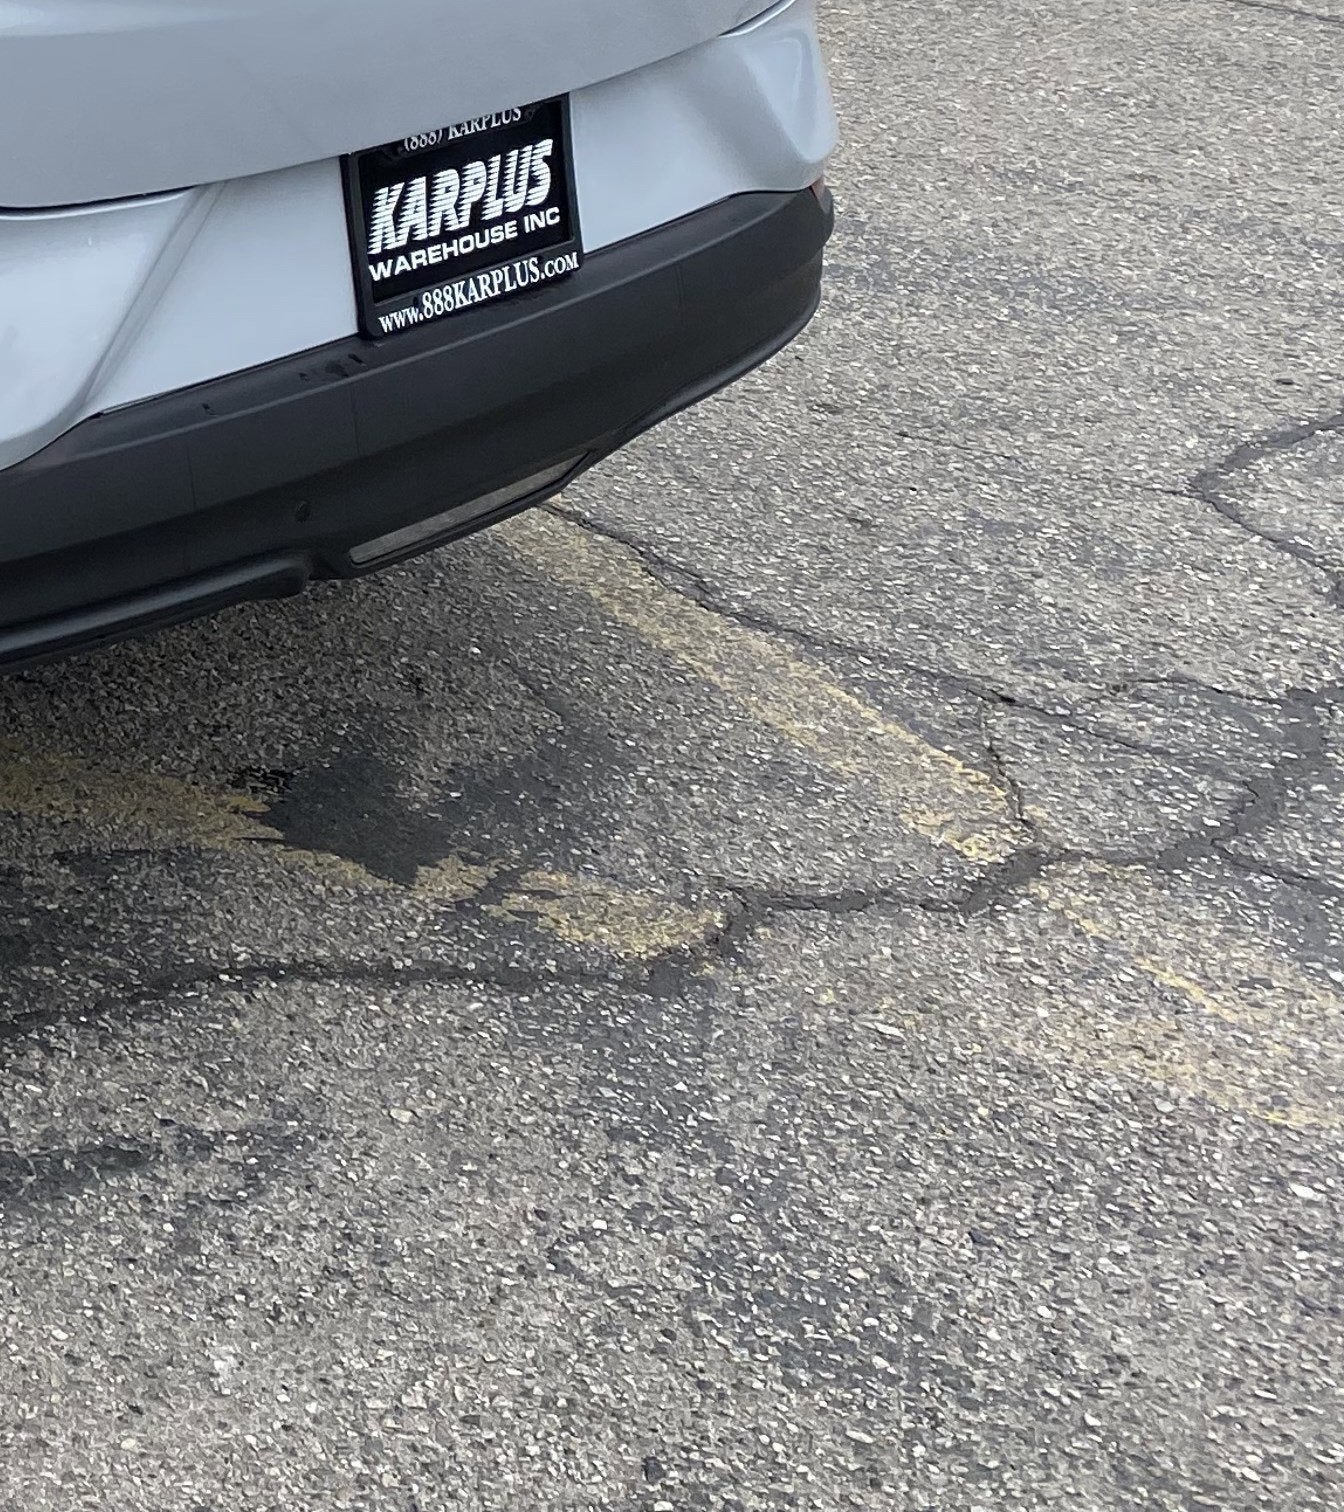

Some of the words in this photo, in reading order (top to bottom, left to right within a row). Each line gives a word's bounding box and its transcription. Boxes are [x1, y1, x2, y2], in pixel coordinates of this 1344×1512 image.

[367, 138, 554, 255] KARPLUS
[368, 220, 518, 281] WAREHOUSE
[524, 206, 561, 233] INC
